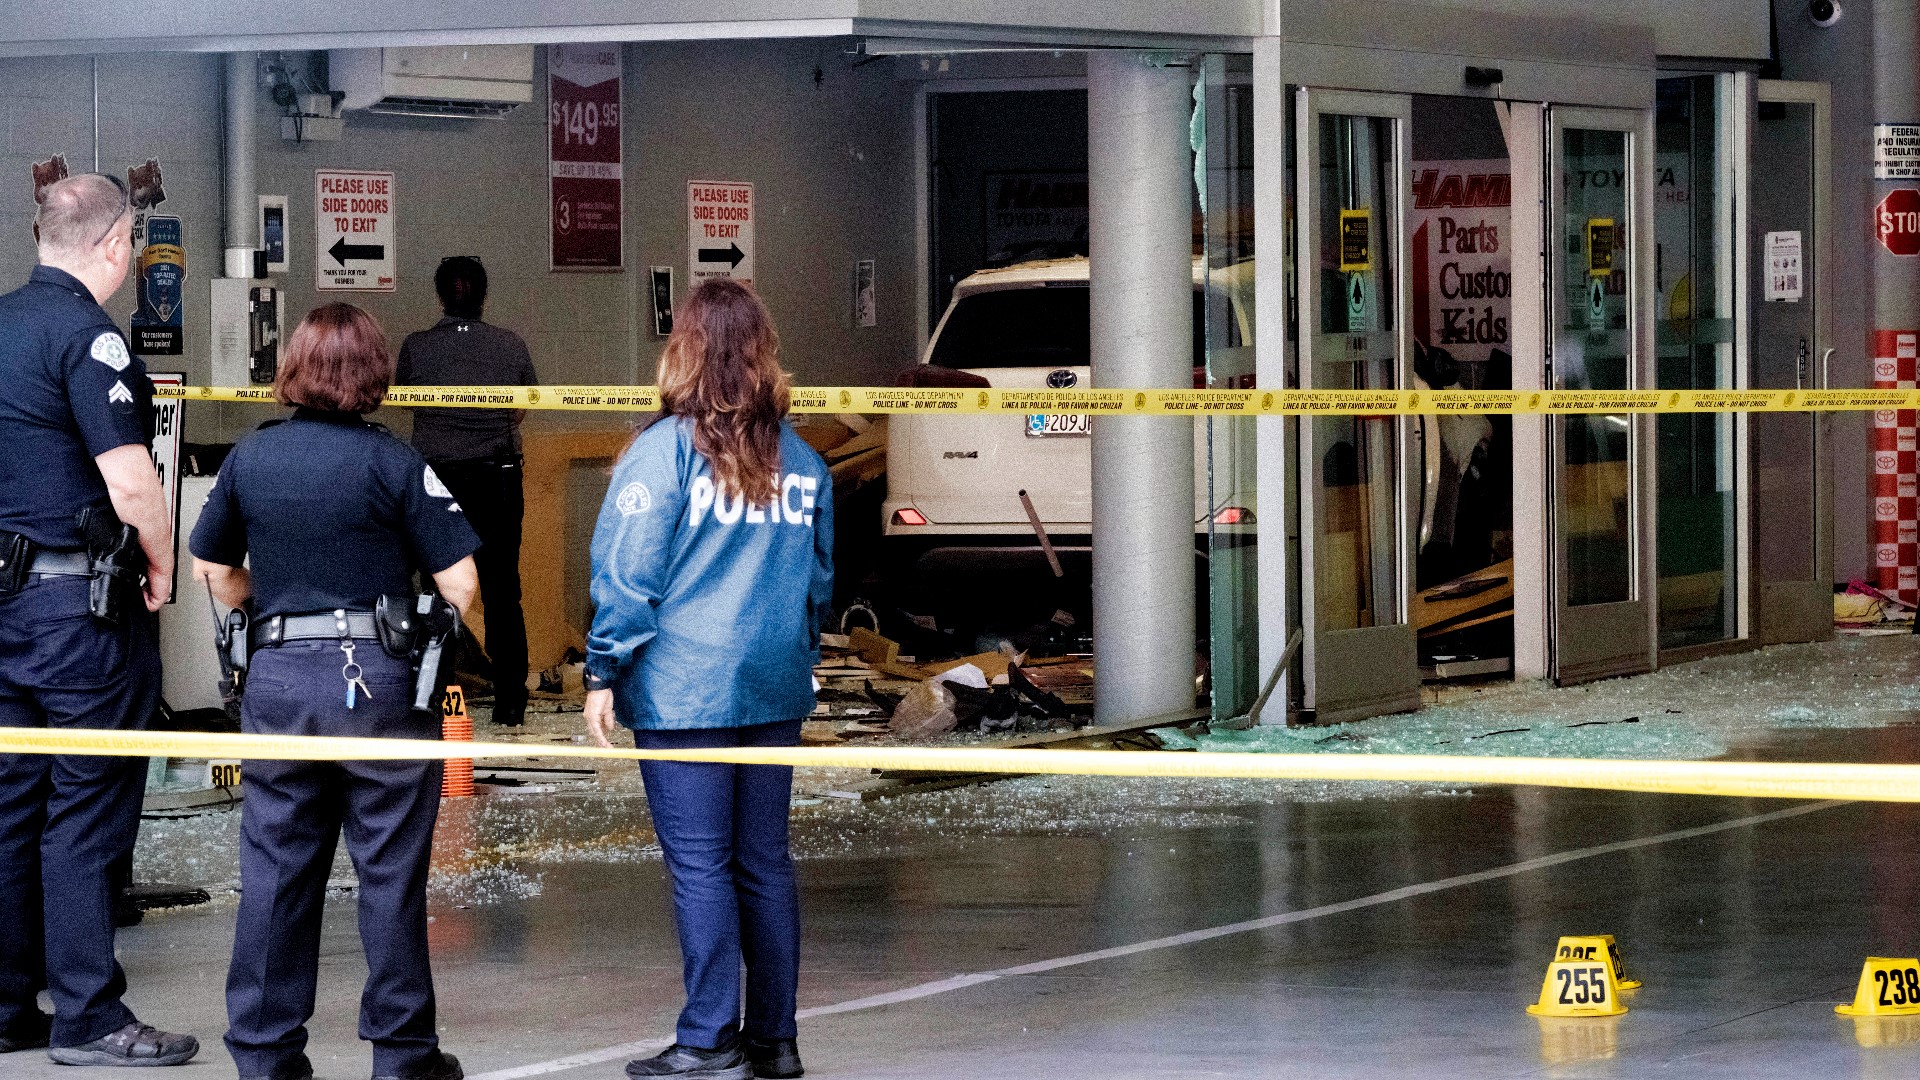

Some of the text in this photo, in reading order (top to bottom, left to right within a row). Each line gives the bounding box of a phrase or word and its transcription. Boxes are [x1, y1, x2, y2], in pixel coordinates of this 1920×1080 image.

[552, 100, 618, 146] $149.95
[1892, 128, 1919, 136] FEDERAL
[322, 179, 388, 194] PLEASE USE
[1578, 168, 1675, 189] TOYA
[693, 188, 748, 203] PLEASE USE
[322, 198, 388, 213] SIDE DOORS
[694, 206, 748, 220] SIDE DOORS
[560, 201, 570, 229] 3
[1880, 212, 1920, 234] STO
[334, 218, 377, 232] TO EXIT
[704, 224, 739, 238] TO EXIT
[1438, 217, 1499, 254] Parts
[1440, 262, 1511, 299] Custo
[1441, 306, 1508, 344] Kids
[94, 340, 104, 354] LOS
[488, 395, 514, 403] CRUZAR
[943, 451, 978, 459] RAV4
[689, 473, 816, 527] POLICE
[1557, 968, 1605, 1004] 255
[1875, 968, 1920, 1006] 238
